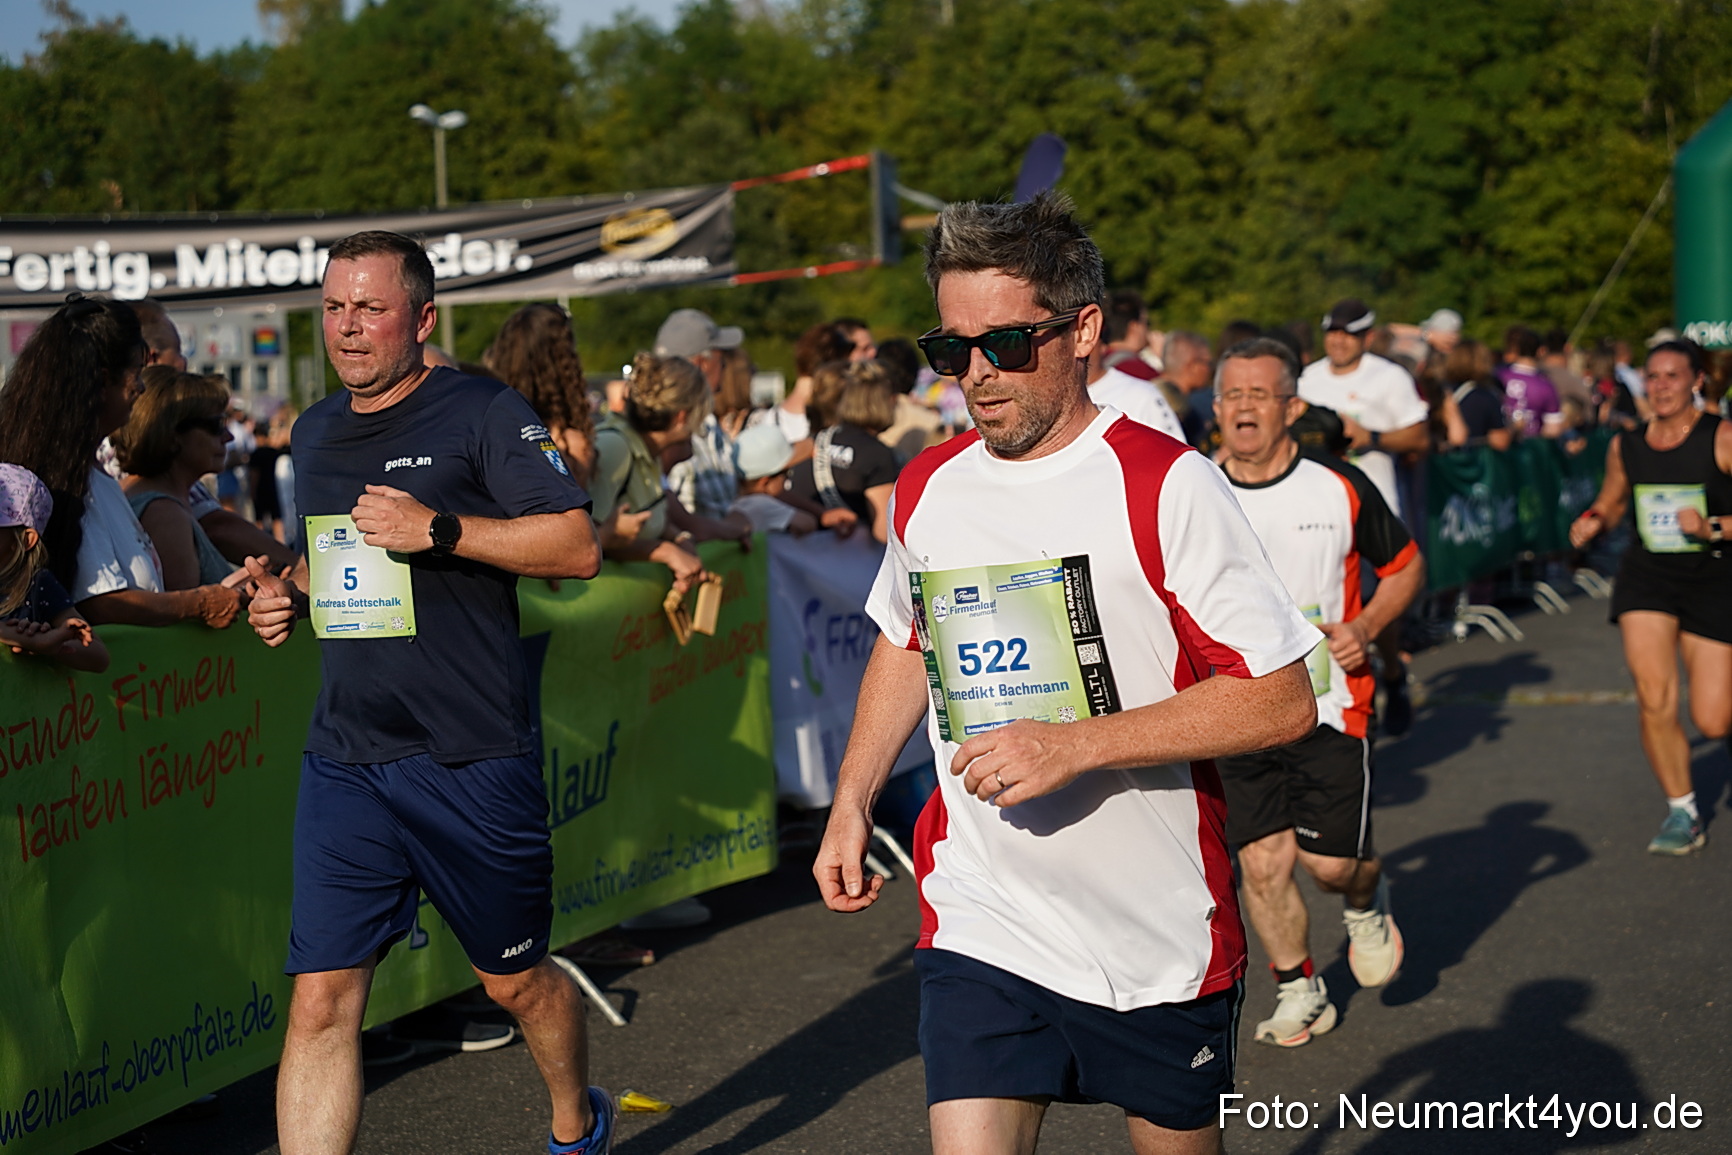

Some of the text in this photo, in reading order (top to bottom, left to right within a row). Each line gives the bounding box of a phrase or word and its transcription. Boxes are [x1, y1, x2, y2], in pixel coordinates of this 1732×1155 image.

[385, 456, 432, 472] gotts_an
[343, 567, 358, 591] 5
[1072, 567, 1081, 598] OUTLET
[316, 597, 402, 608] Andreas Gottschalk
[950, 599, 997, 615] Firmenlauf
[1063, 567, 1080, 635] 20 % RABATT
[1076, 599, 1088, 633] FACTORY
[957, 637, 1031, 676] 522
[112, 655, 237, 733] Firmen
[947, 681, 1070, 701] Benedikt Bachmann
[1089, 667, 1109, 717] HILTL
[17, 699, 265, 863] laufen länger!
[501, 938, 533, 958] JAKO
[1190, 1052, 1215, 1069] adidas
